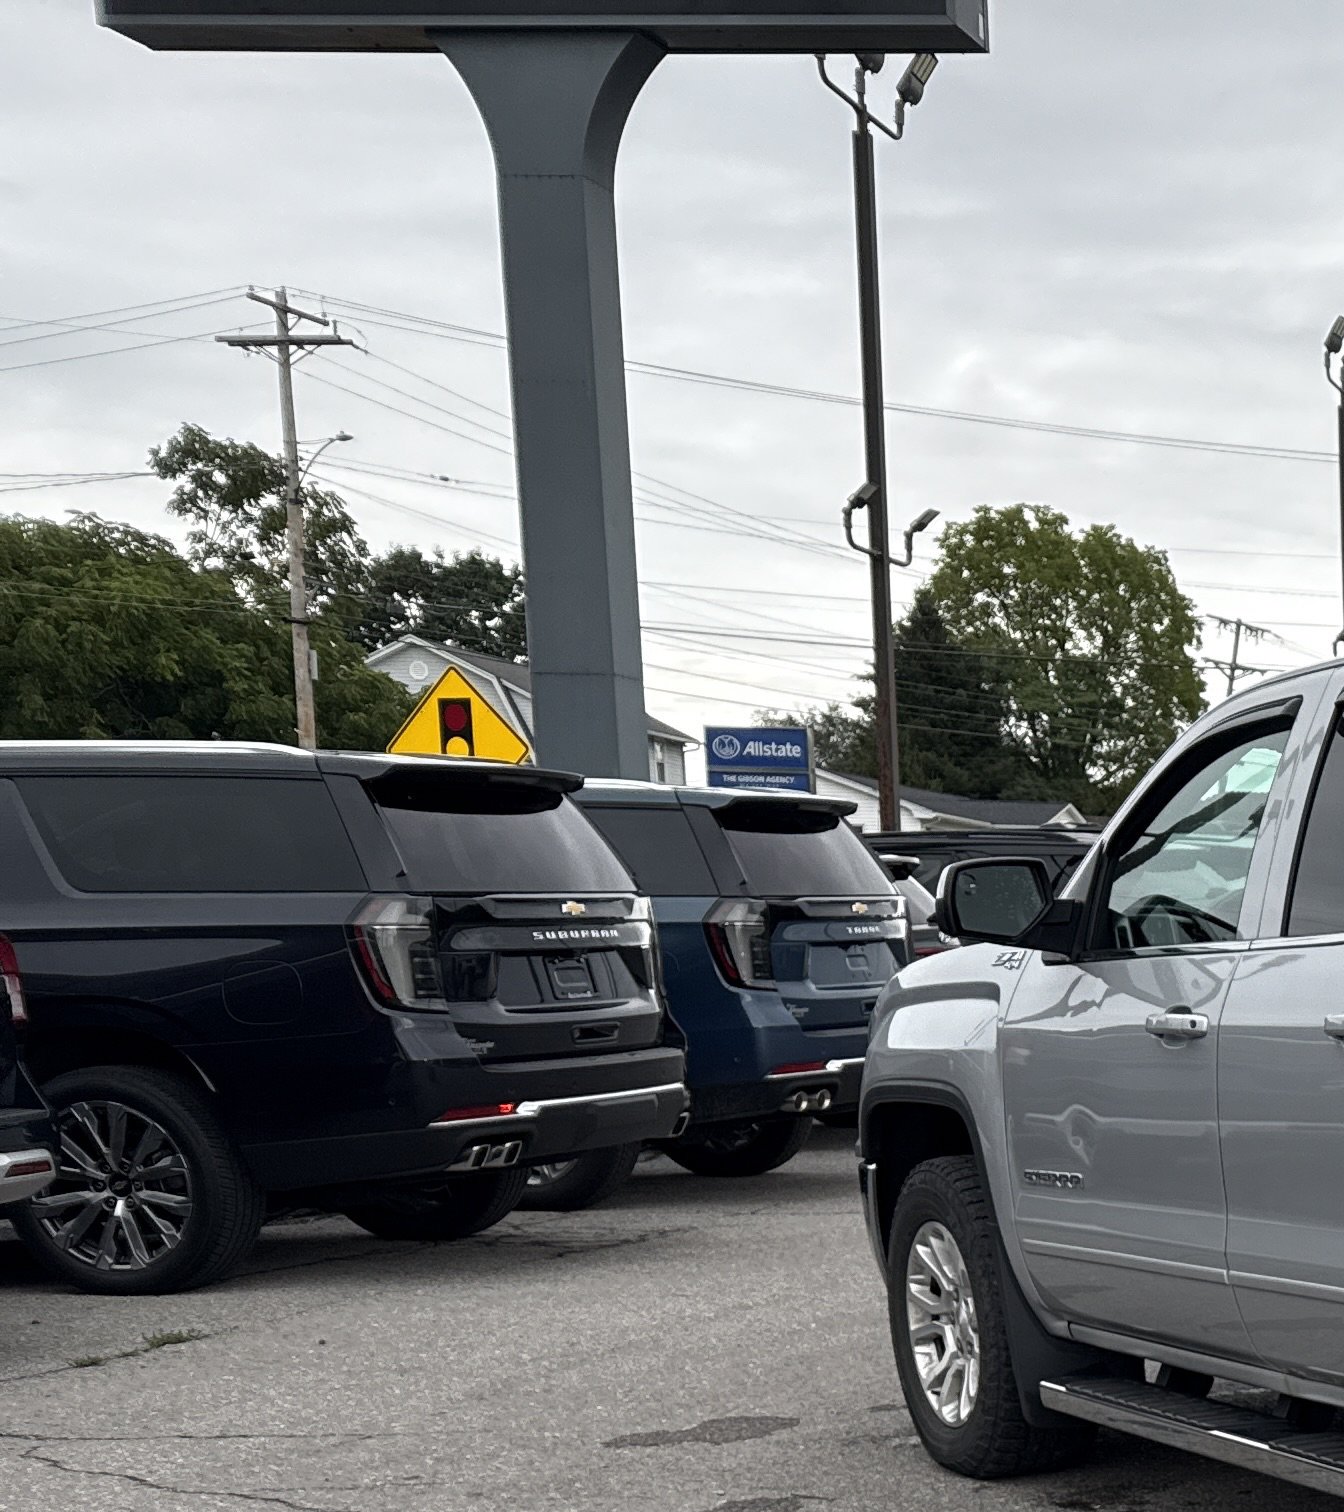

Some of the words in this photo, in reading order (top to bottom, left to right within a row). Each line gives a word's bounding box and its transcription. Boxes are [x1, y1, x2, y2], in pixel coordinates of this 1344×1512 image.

[743, 740, 802, 757] Allstate
[765, 776, 795, 784] AGENCY
[533, 929, 619, 941] SUBURBAN
[1024, 1168, 1085, 1191] SIERRA
